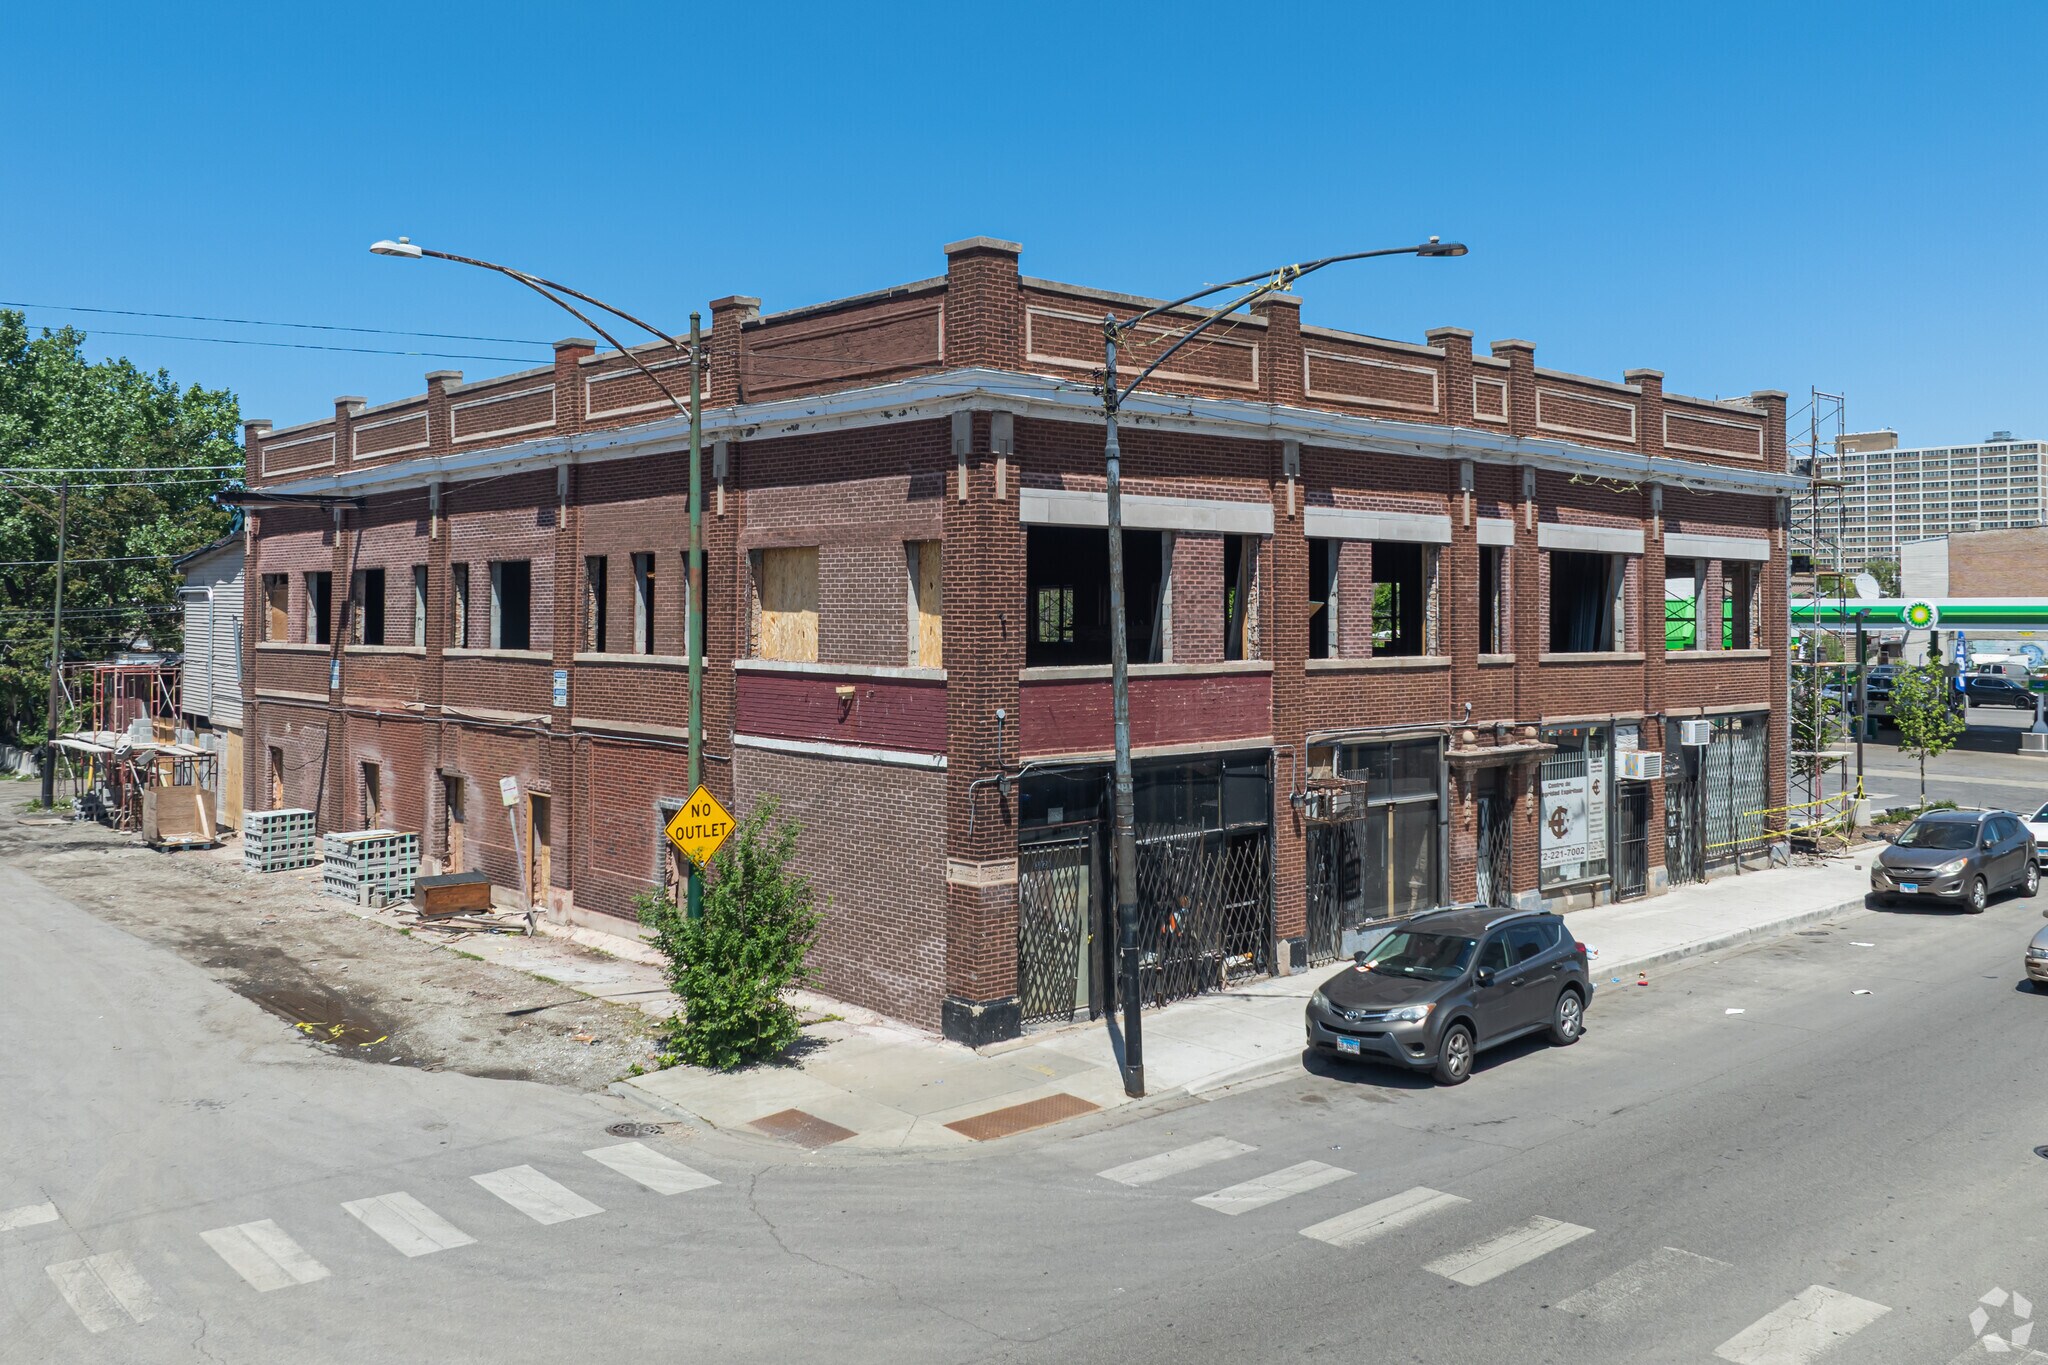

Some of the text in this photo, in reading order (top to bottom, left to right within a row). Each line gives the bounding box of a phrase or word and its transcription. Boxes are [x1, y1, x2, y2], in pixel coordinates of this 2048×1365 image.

[691, 803, 711, 818] NO
[676, 823, 726, 840] OUTLET
[1541, 847, 1585, 861] 2-221-7002
